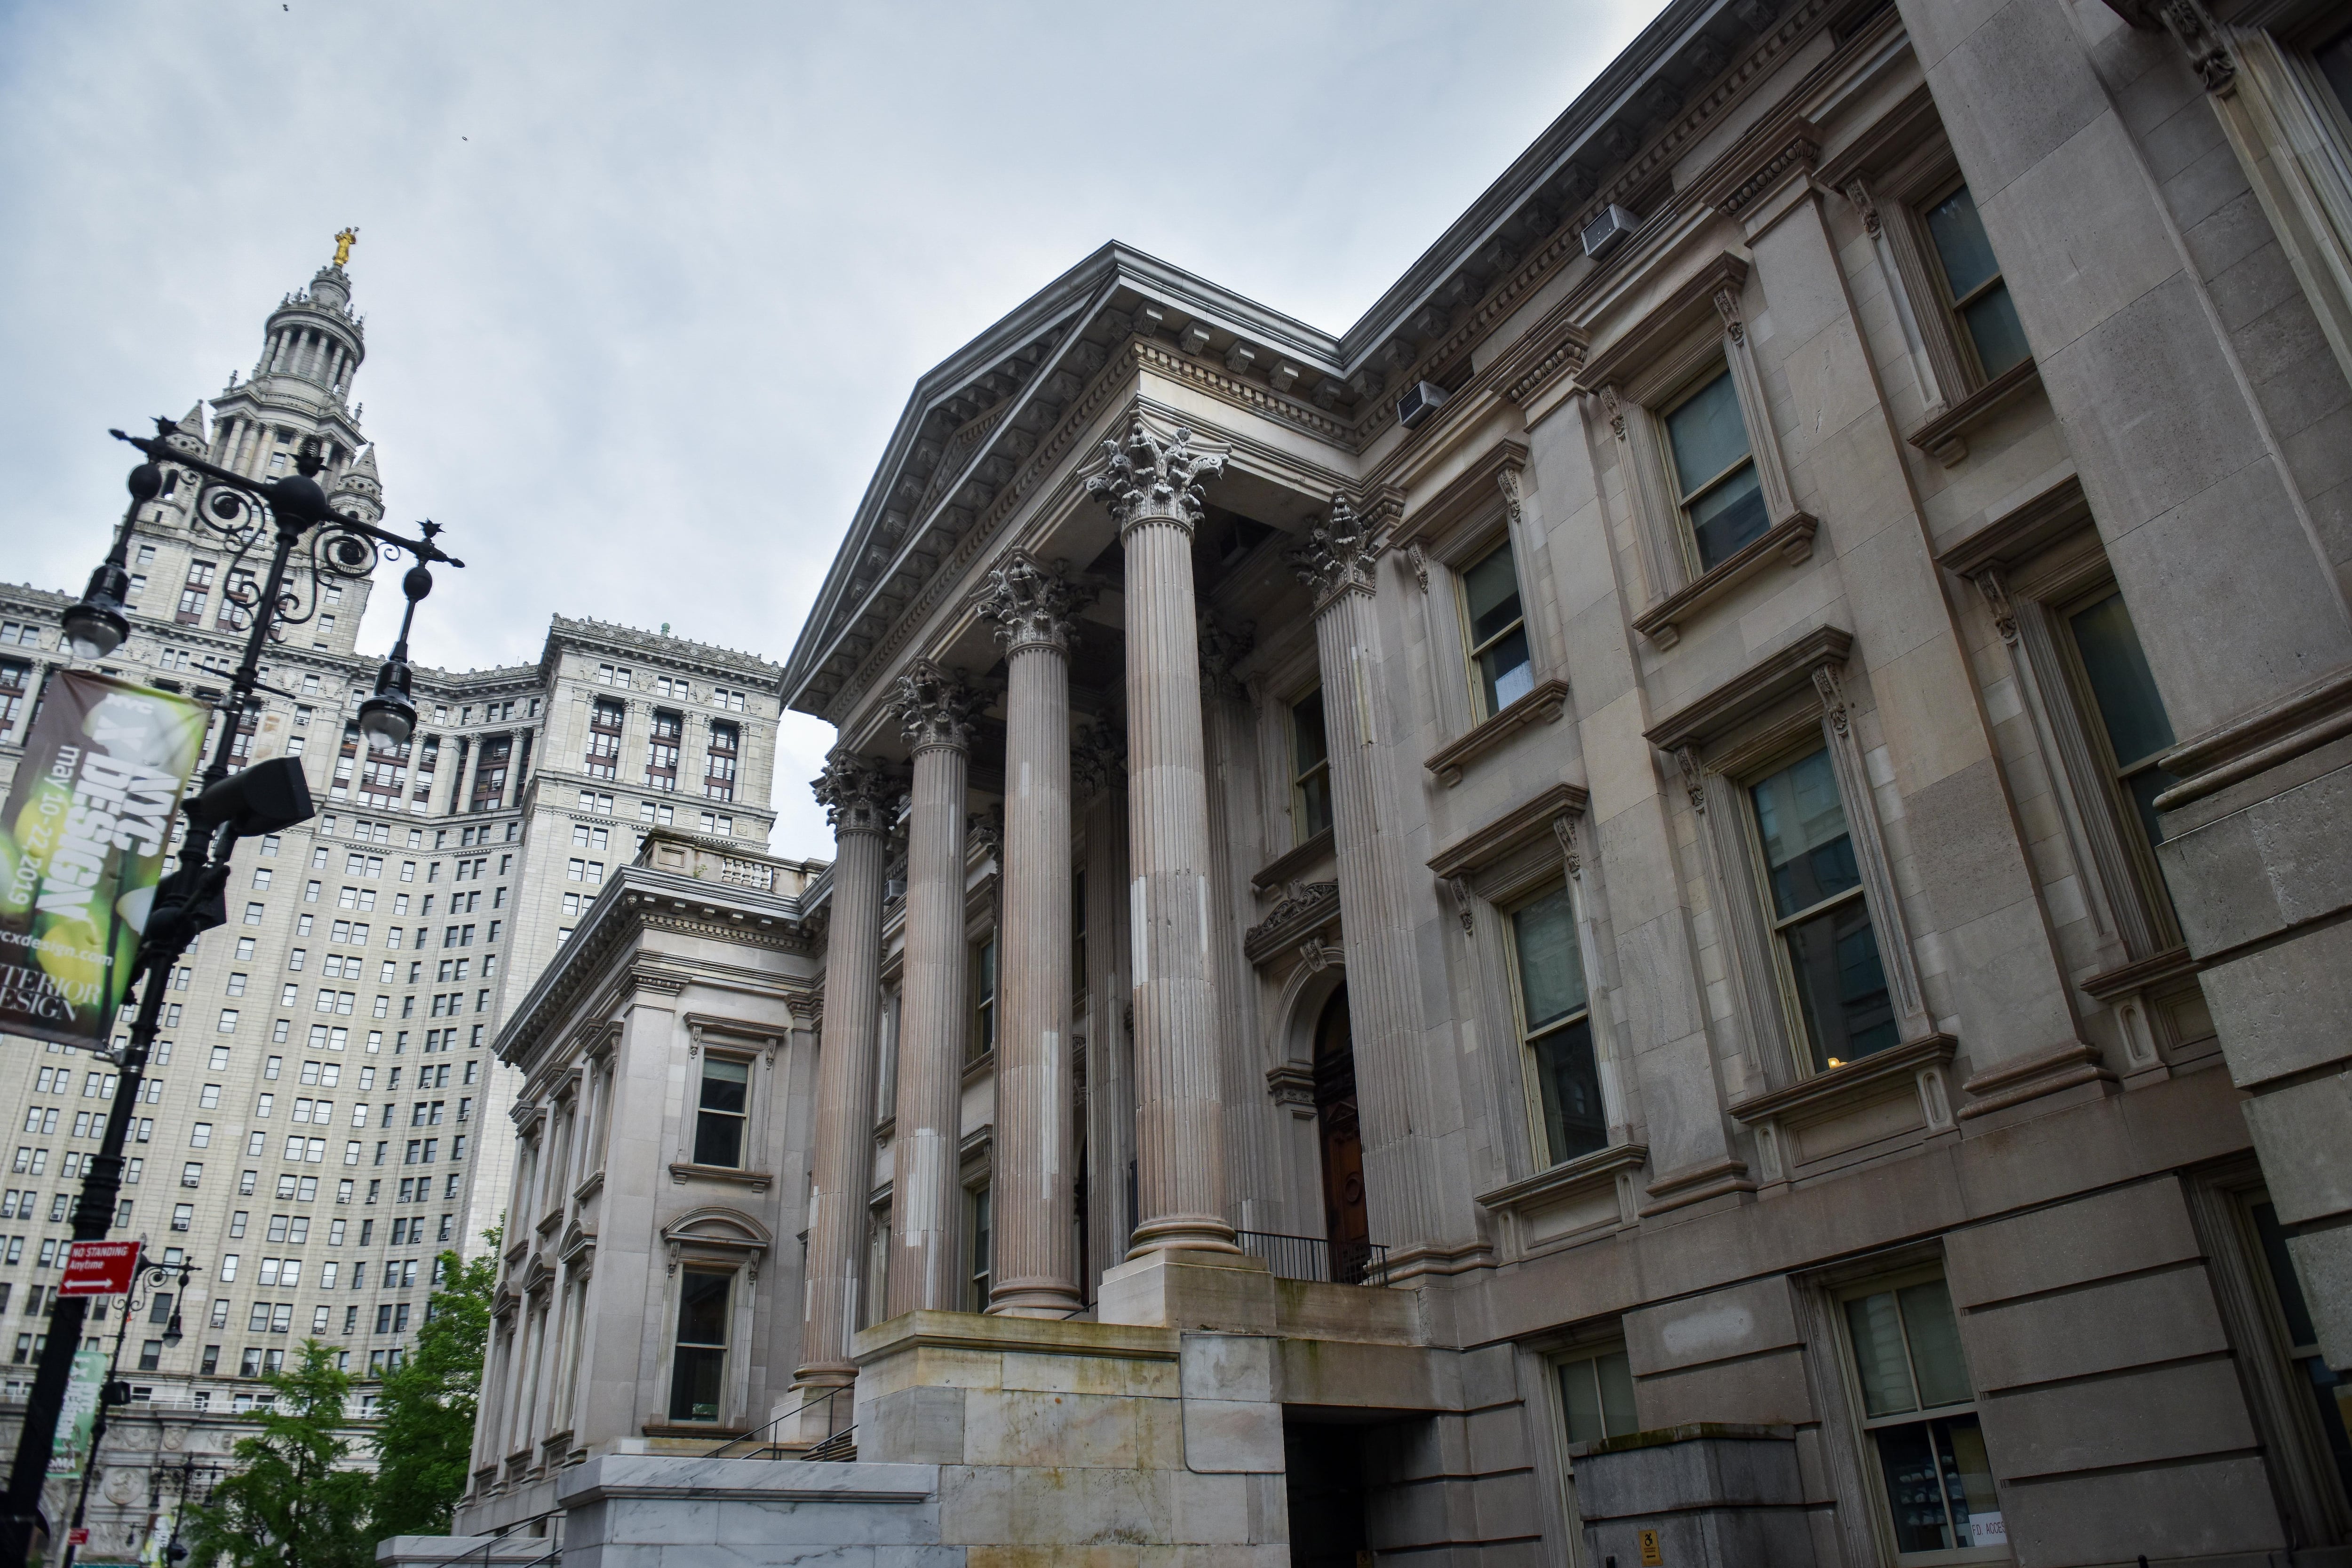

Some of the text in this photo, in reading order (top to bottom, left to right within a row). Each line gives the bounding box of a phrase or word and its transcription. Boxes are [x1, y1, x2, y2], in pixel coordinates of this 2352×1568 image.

[44, 745, 81, 791] may
[111, 764, 182, 858] NYC
[35, 752, 134, 921] DESIGN
[7, 853, 43, 906] 2019
[0, 930, 113, 966] cxdesign.com
[69, 1260, 104, 1272] Anytime
[72, 1246, 129, 1258] NO STANDING
[1971, 1524, 1983, 1536] F.D.
